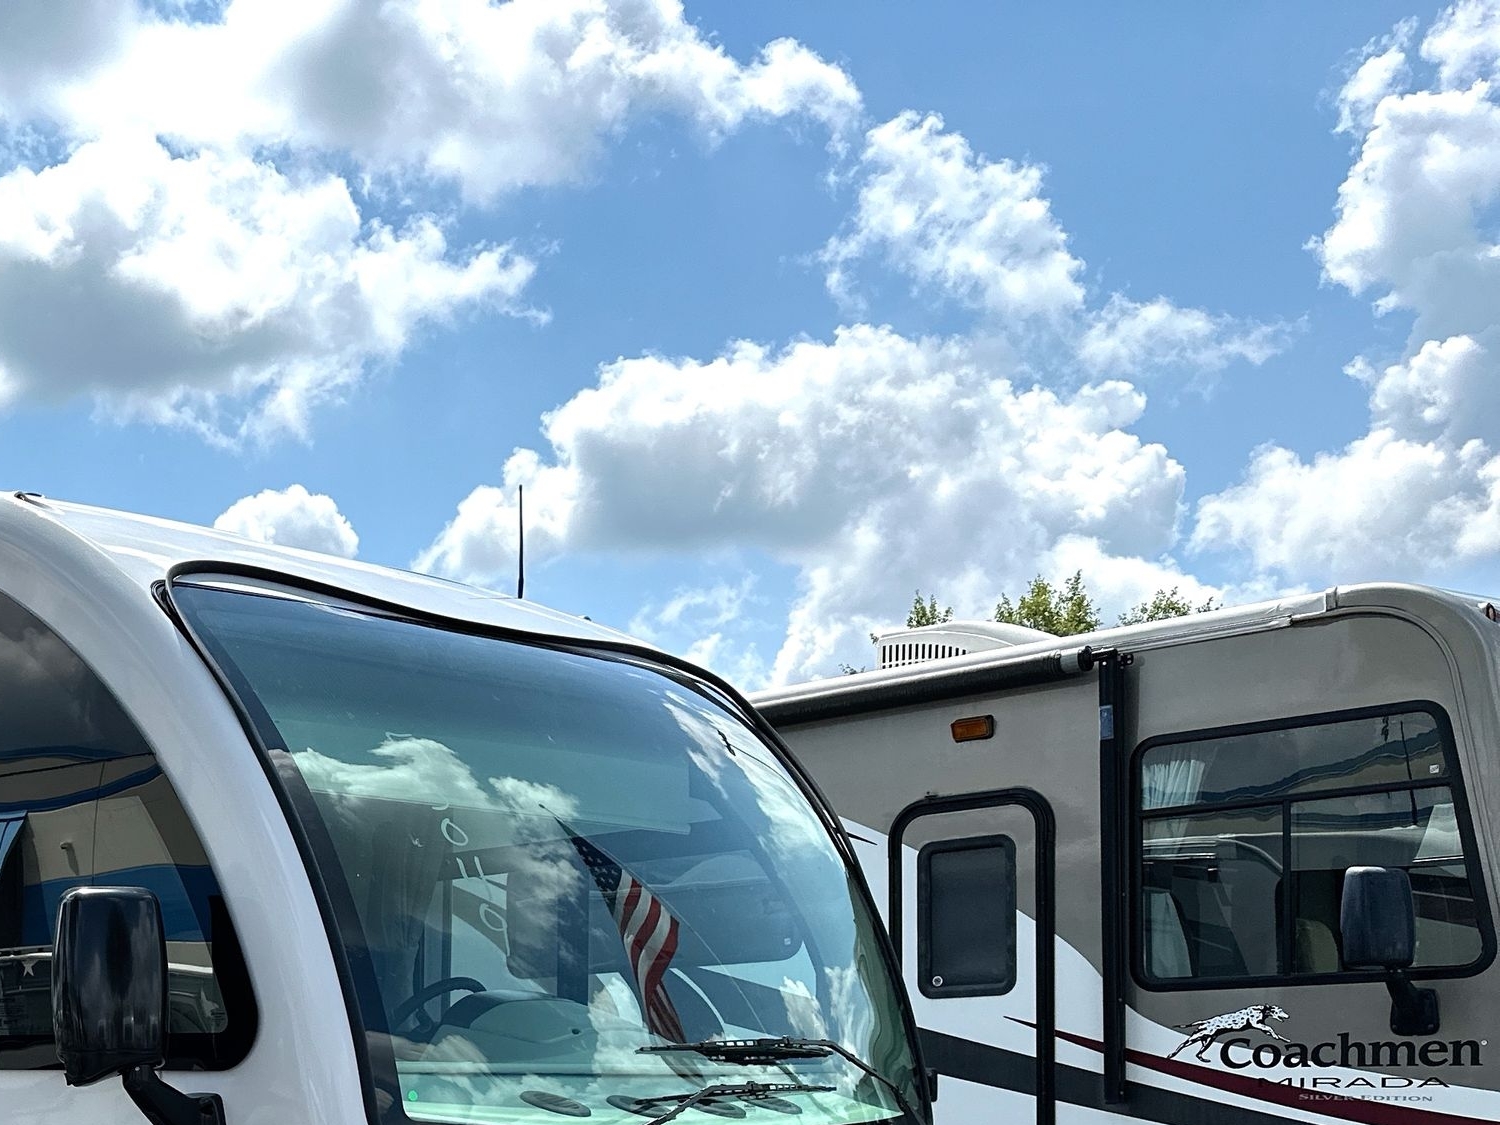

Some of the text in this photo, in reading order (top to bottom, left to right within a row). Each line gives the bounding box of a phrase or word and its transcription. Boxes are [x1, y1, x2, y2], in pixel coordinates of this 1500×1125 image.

[1219, 1032, 1483, 1069] Coachmen
[1258, 1077, 1450, 1088] MIRADA
[1298, 1093, 1433, 1102] SILVER EDITION
